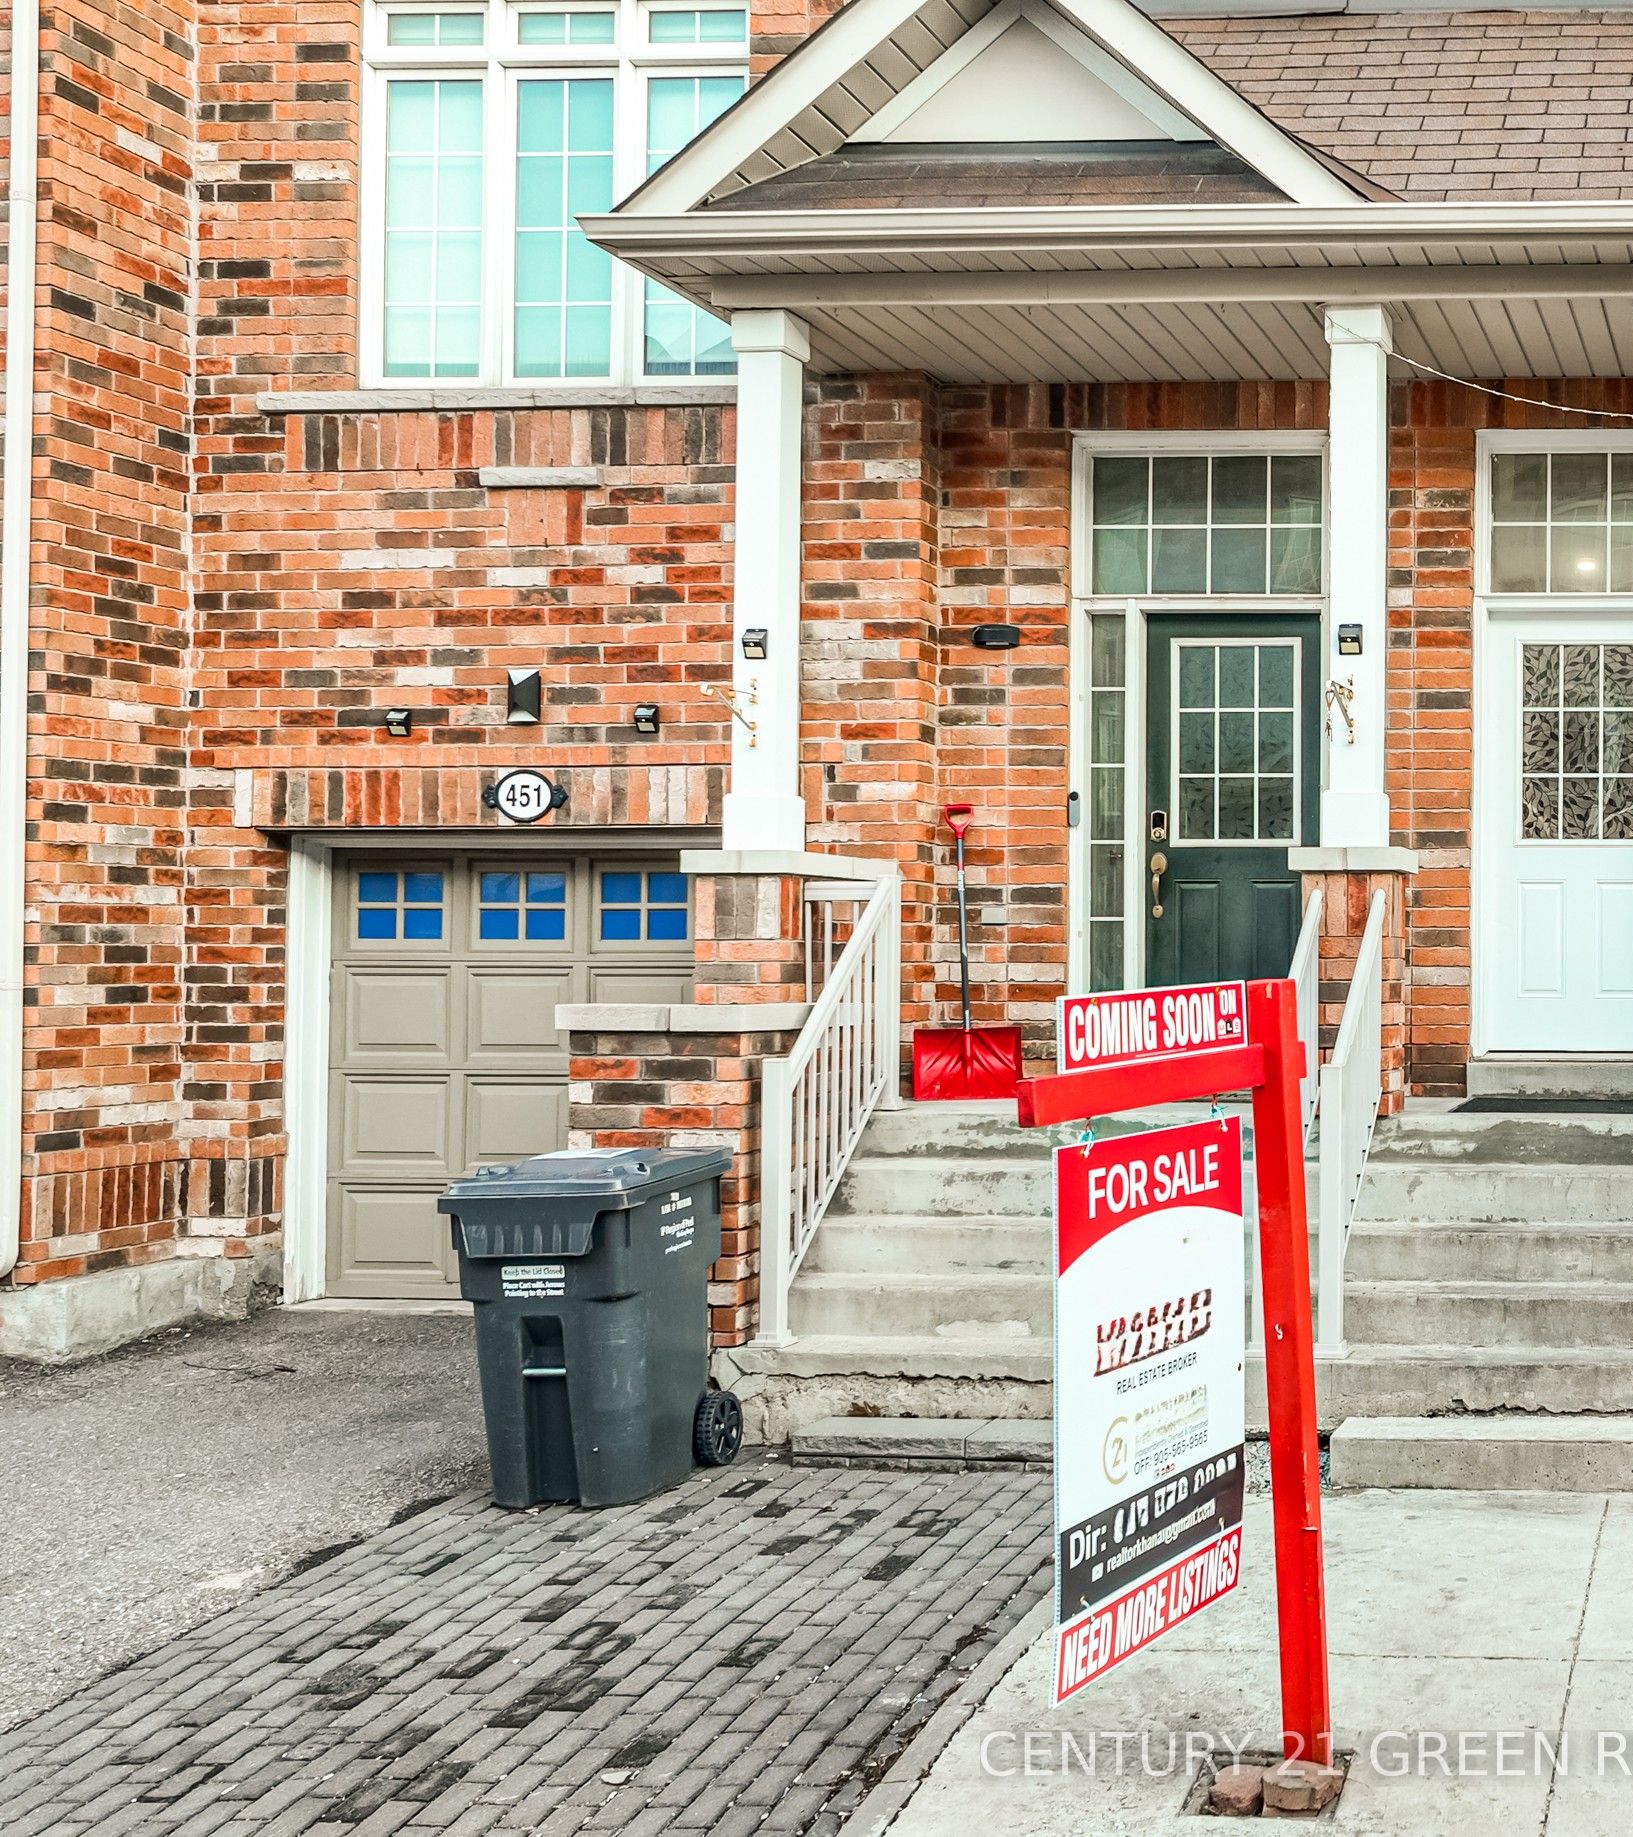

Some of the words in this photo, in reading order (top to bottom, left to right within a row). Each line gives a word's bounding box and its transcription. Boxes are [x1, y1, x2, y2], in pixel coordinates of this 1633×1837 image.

[506, 784, 541, 807] 451
[1219, 989, 1237, 1016] ON
[1068, 996, 1157, 1062] COMING
[1162, 992, 1216, 1048] SOON
[1088, 1158, 1149, 1220] FOR
[1153, 1143, 1220, 1203] SALE
[504, 1268, 519, 1277] Keep
[543, 1266, 563, 1275] Closed
[1116, 1375, 1137, 1395] REAL
[1139, 1363, 1166, 1387] ESTATE
[1168, 1351, 1198, 1375] BROKER
[1069, 1523, 1108, 1569] Dir:
[1061, 1610, 1114, 1693] NEED
[1114, 1576, 1169, 1659] MORE
[1168, 1533, 1239, 1624] LISTINGS
